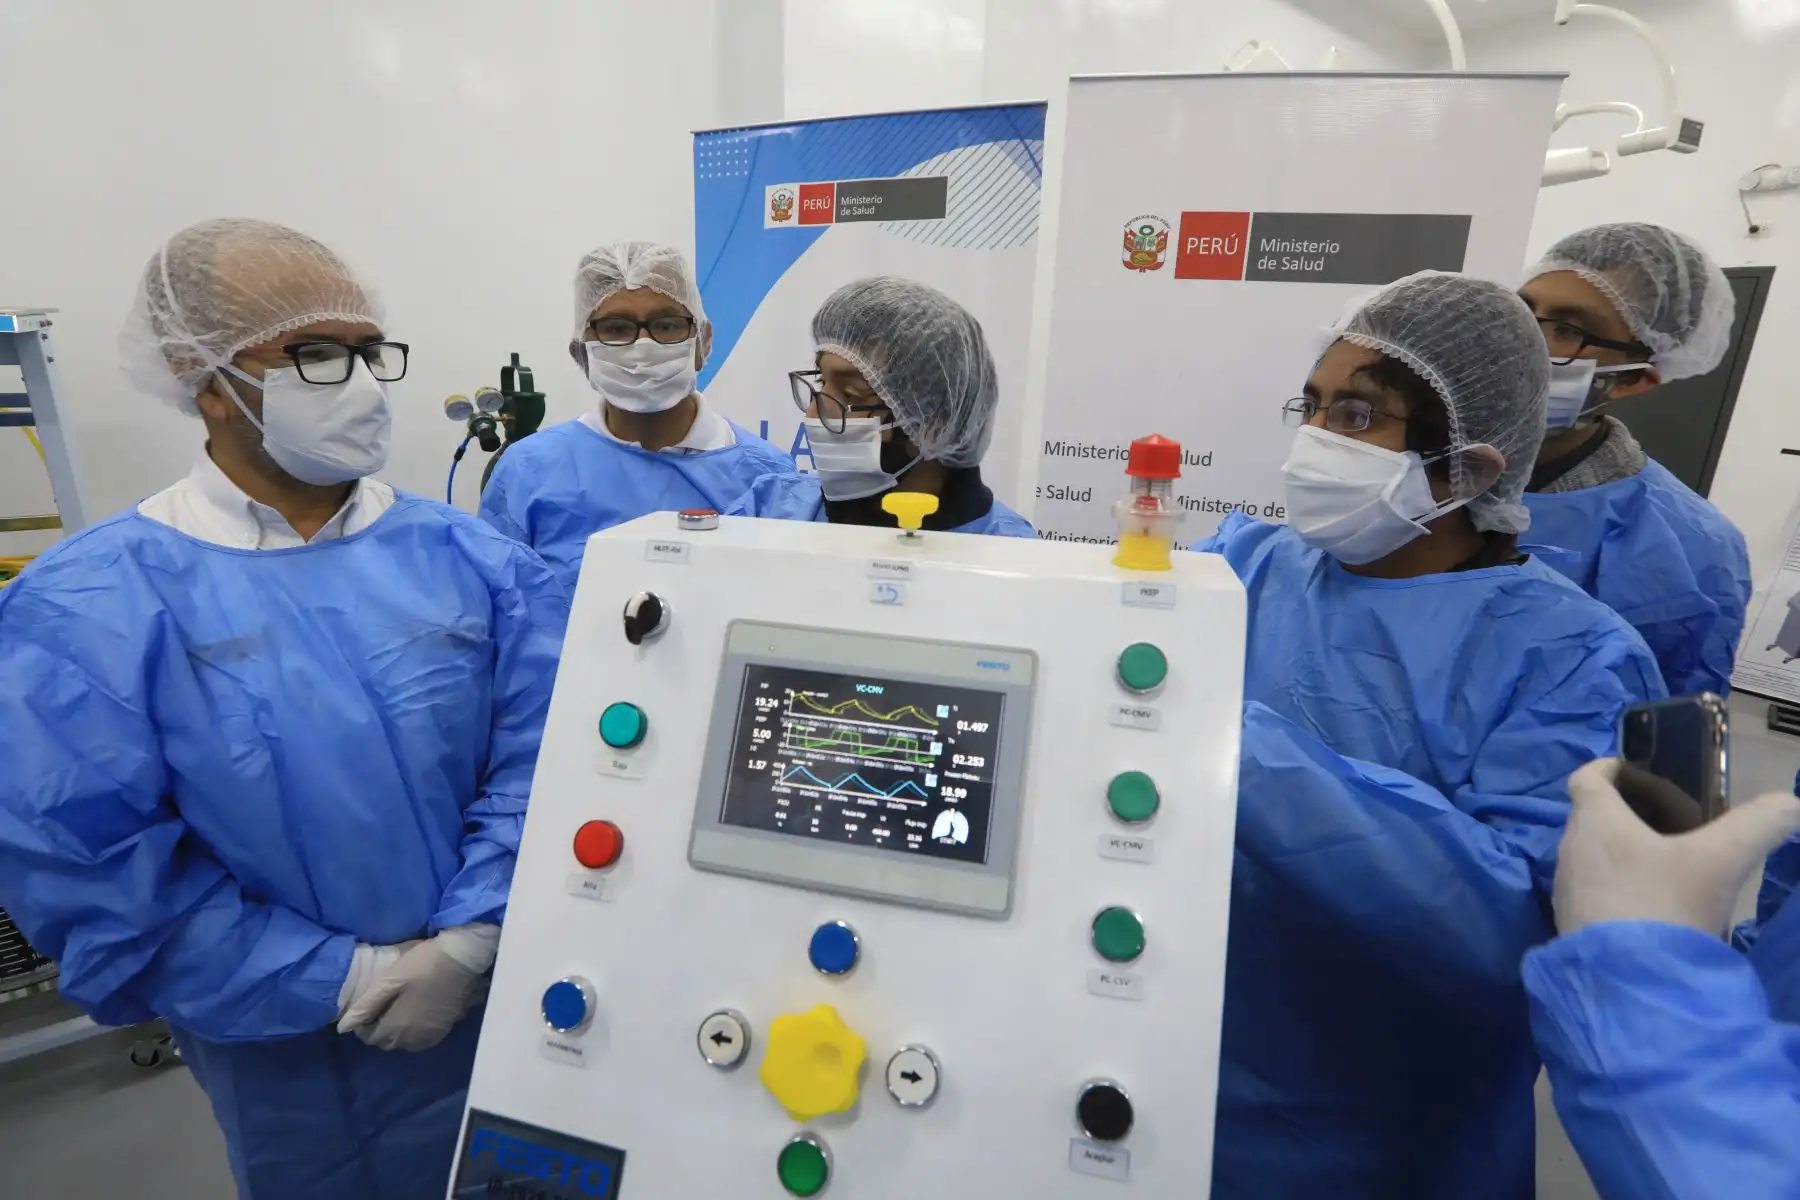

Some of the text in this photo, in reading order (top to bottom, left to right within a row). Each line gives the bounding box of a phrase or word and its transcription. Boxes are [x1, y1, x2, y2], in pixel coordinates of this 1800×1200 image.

[803, 195, 831, 211] PERÚ
[840, 194, 883, 206] Ministerio
[840, 205, 876, 216] de Salud
[1187, 232, 1239, 255] PERÚ
[1260, 238, 1340, 254] Ministerio
[1257, 255, 1325, 271] de Salud
[1044, 441, 1130, 461] Ministerio
[1046, 484, 1092, 502] Salud
[1263, 501, 1286, 518] de
[755, 696, 779, 708] 19.24
[752, 728, 772, 740] 5.00
[470, 1127, 609, 1196] FESTO
